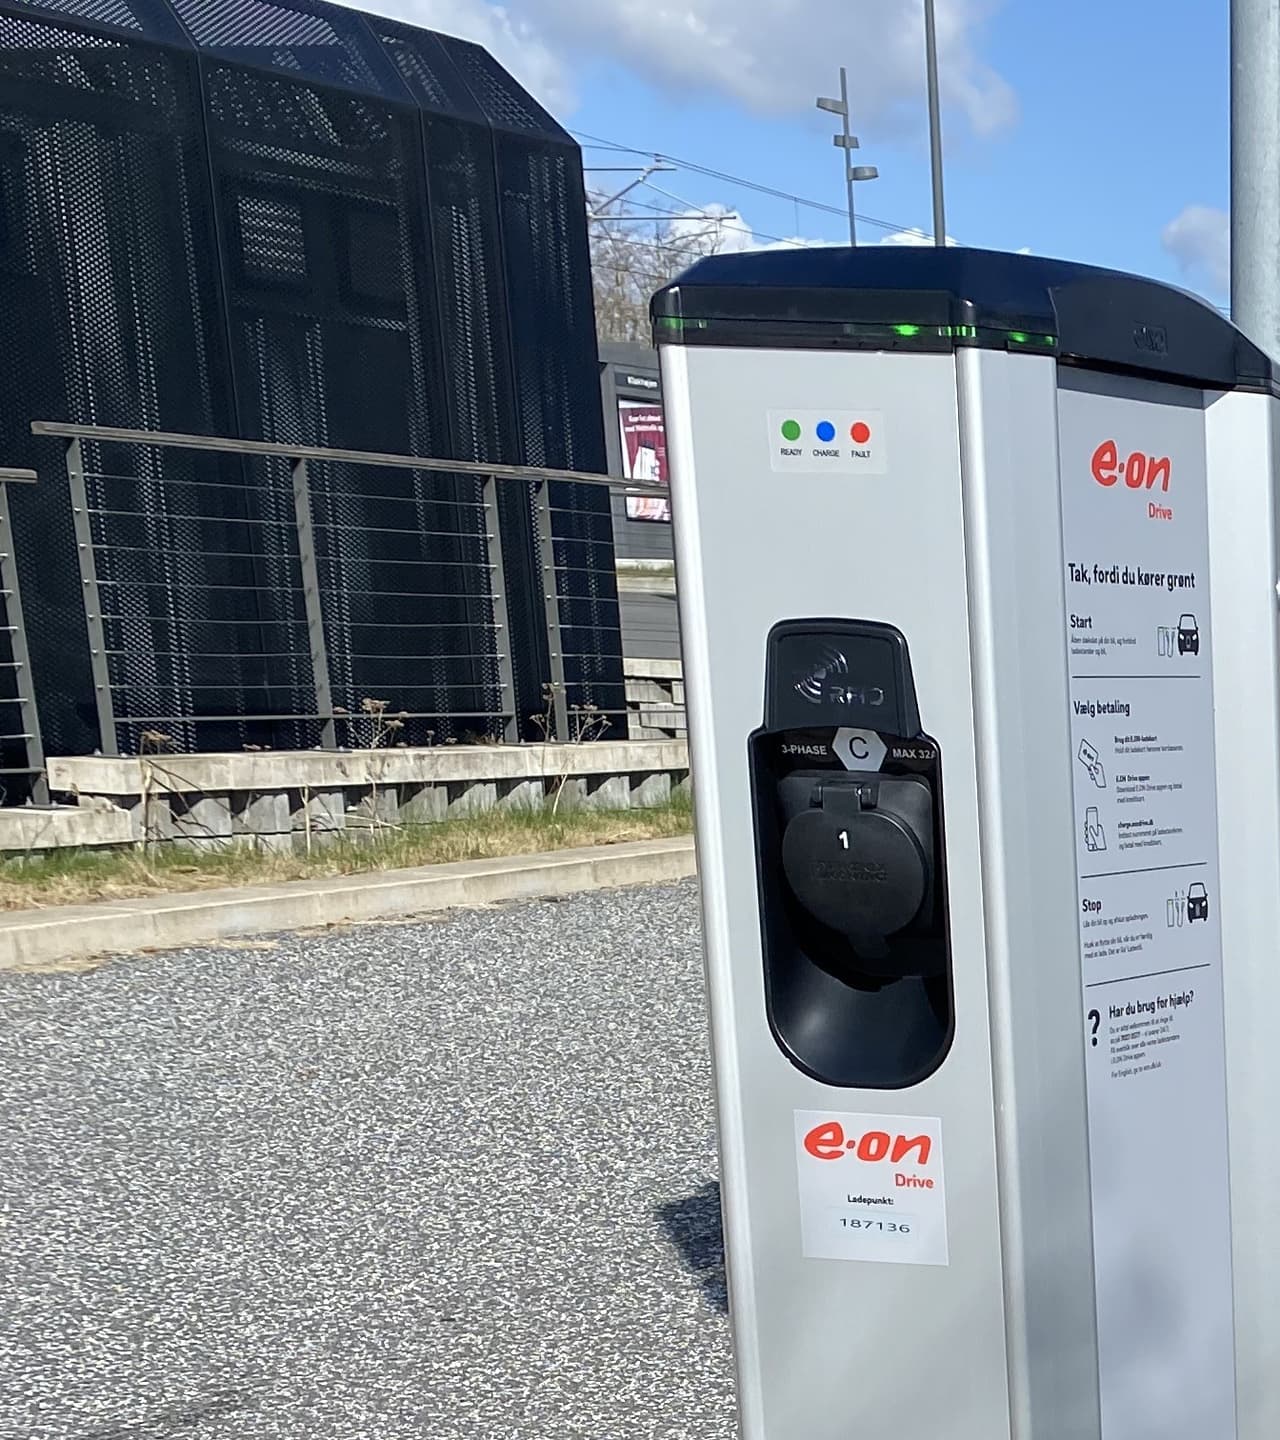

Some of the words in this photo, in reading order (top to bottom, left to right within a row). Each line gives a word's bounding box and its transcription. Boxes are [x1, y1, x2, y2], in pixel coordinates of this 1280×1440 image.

[780, 447, 803, 456] READY
[812, 449, 840, 457] CHARGE
[851, 450, 871, 458] FAULT
[1148, 503, 1173, 520] Drive
[1068, 563, 1092, 585] Tak,
[1093, 564, 1120, 584] fordi
[1121, 565, 1136, 585] du
[1137, 567, 1165, 587] kører
[1167, 572, 1196, 592] grønt
[1070, 614, 1093, 629] Start
[1073, 700, 1096, 718] Vælg
[1096, 699, 1130, 717] betaling
[781, 744, 828, 756] 3-PHASE
[849, 736, 869, 759] C
[893, 748, 917, 759] MAX
[839, 831, 849, 849] 1
[1082, 898, 1102, 915] Stop
[1109, 1005, 1125, 1019] Har
[1125, 1002, 1136, 1016] du
[1137, 1000, 1156, 1014] brug
[1157, 996, 1169, 1010] for
[1169, 990, 1194, 1010] hjælp?
[895, 1173, 934, 1189] Drive
[847, 1194, 894, 1206] Ladepunkt:
[840, 1218, 911, 1234] 187136
